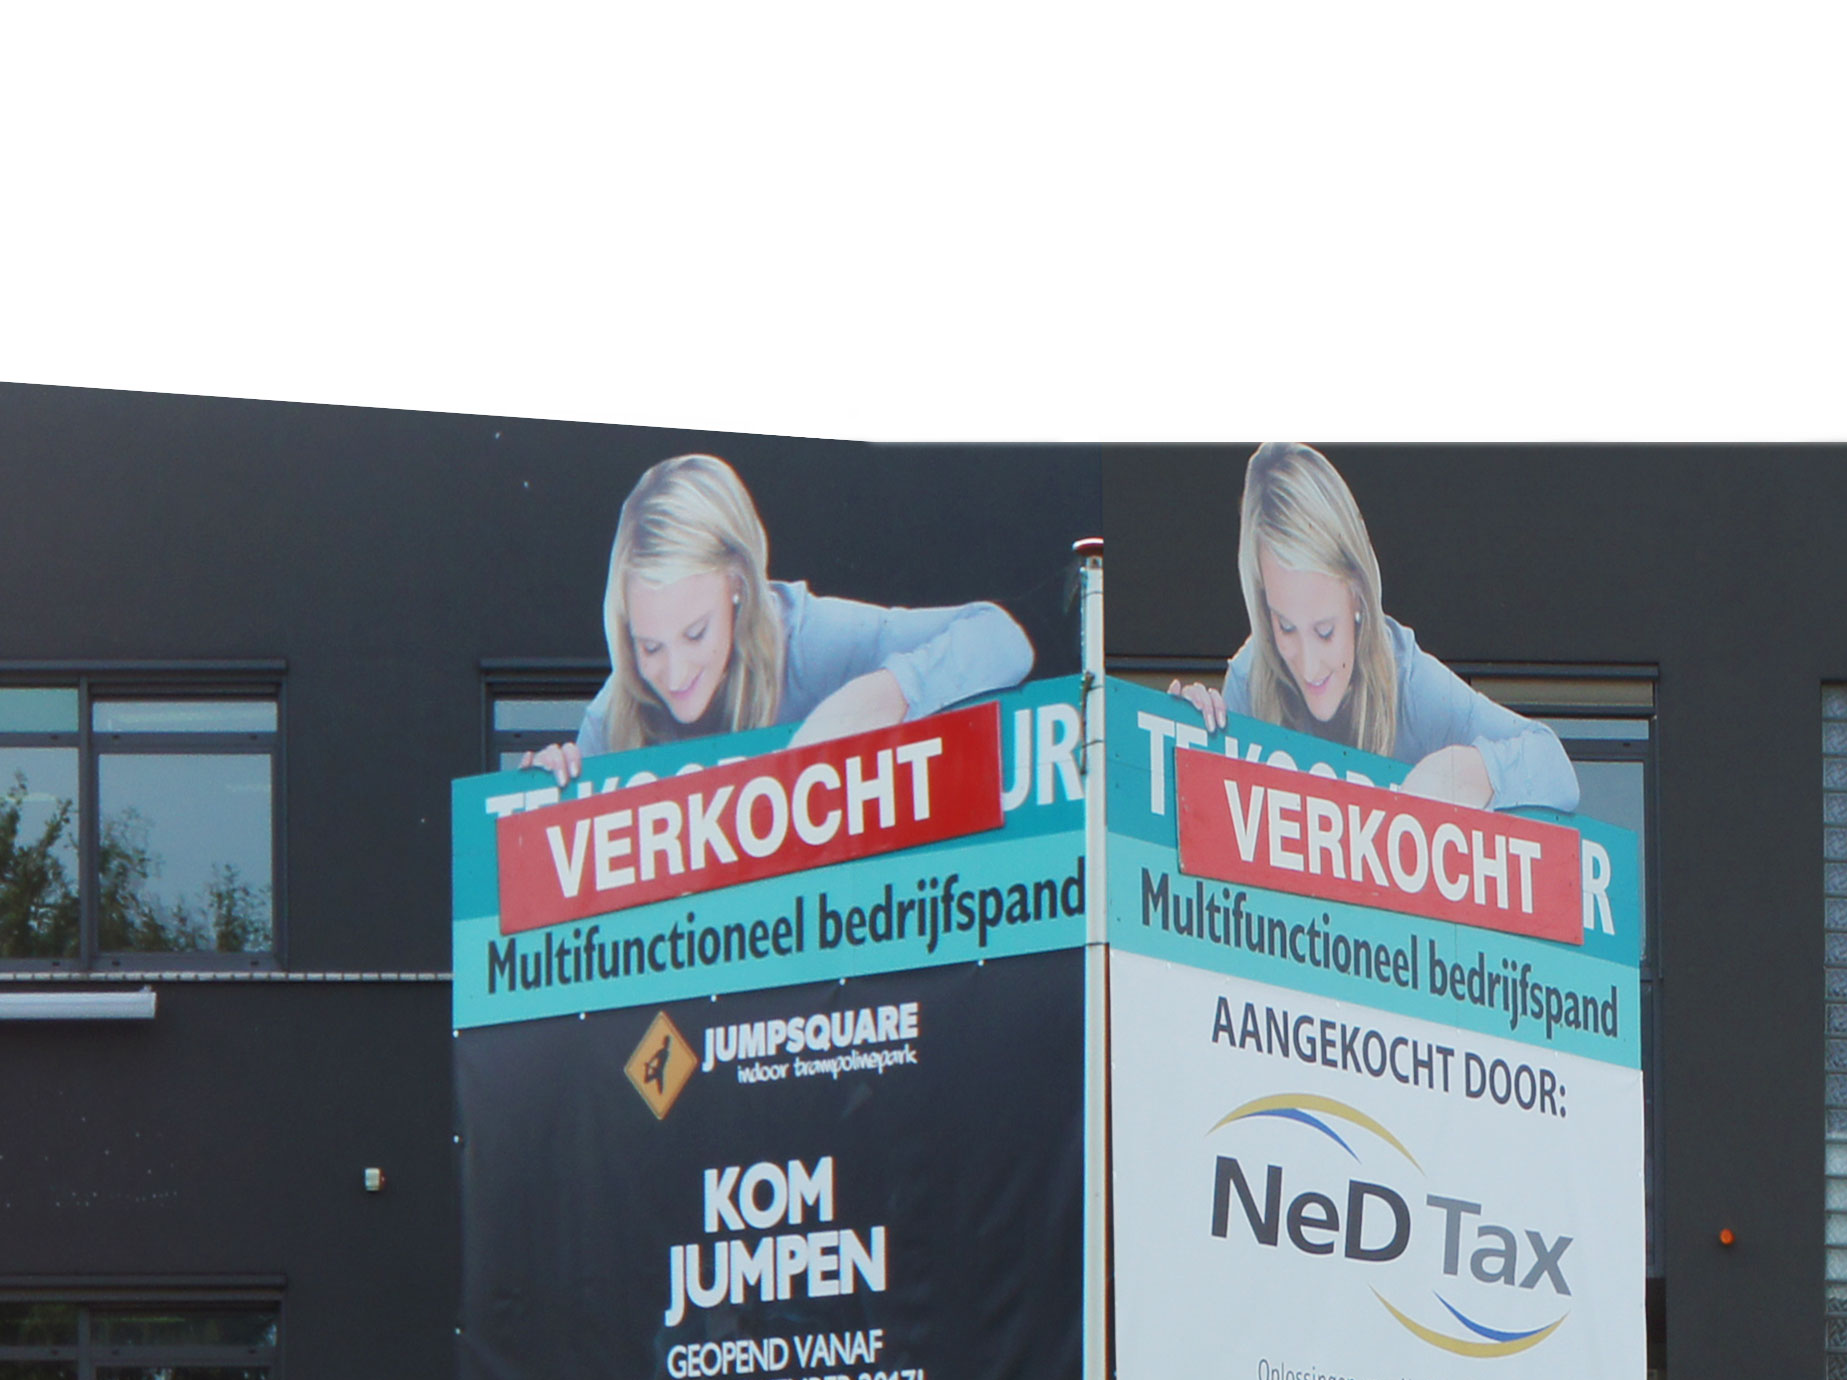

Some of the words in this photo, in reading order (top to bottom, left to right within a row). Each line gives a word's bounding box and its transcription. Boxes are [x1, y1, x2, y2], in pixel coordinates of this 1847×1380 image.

[546, 737, 943, 899] VERKOCHT
[1137, 711, 1208, 816] T
[1223, 779, 1542, 914] VERKOCHT
[487, 897, 804, 994] Multifunctioneel
[818, 856, 1086, 954] bedrijfspand
[1140, 867, 1419, 991] Multifunctioneel
[1429, 939, 1619, 1039] bedrijfspand
[702, 1002, 920, 1073] JUMPSQUARE
[737, 1061, 789, 1084] indoor
[793, 1043, 918, 1080] trampolinepark
[1211, 995, 1455, 1094] AANGEKOCHT
[1465, 1050, 1567, 1119] DOOR:
[704, 1156, 834, 1233] KOM
[1210, 1154, 1412, 1264] NeD
[1425, 1193, 1575, 1297] Tax
[664, 1225, 887, 1328] JUMPEN
[667, 1337, 789, 1380] GEOPEND
[794, 1329, 884, 1369] VANAF
